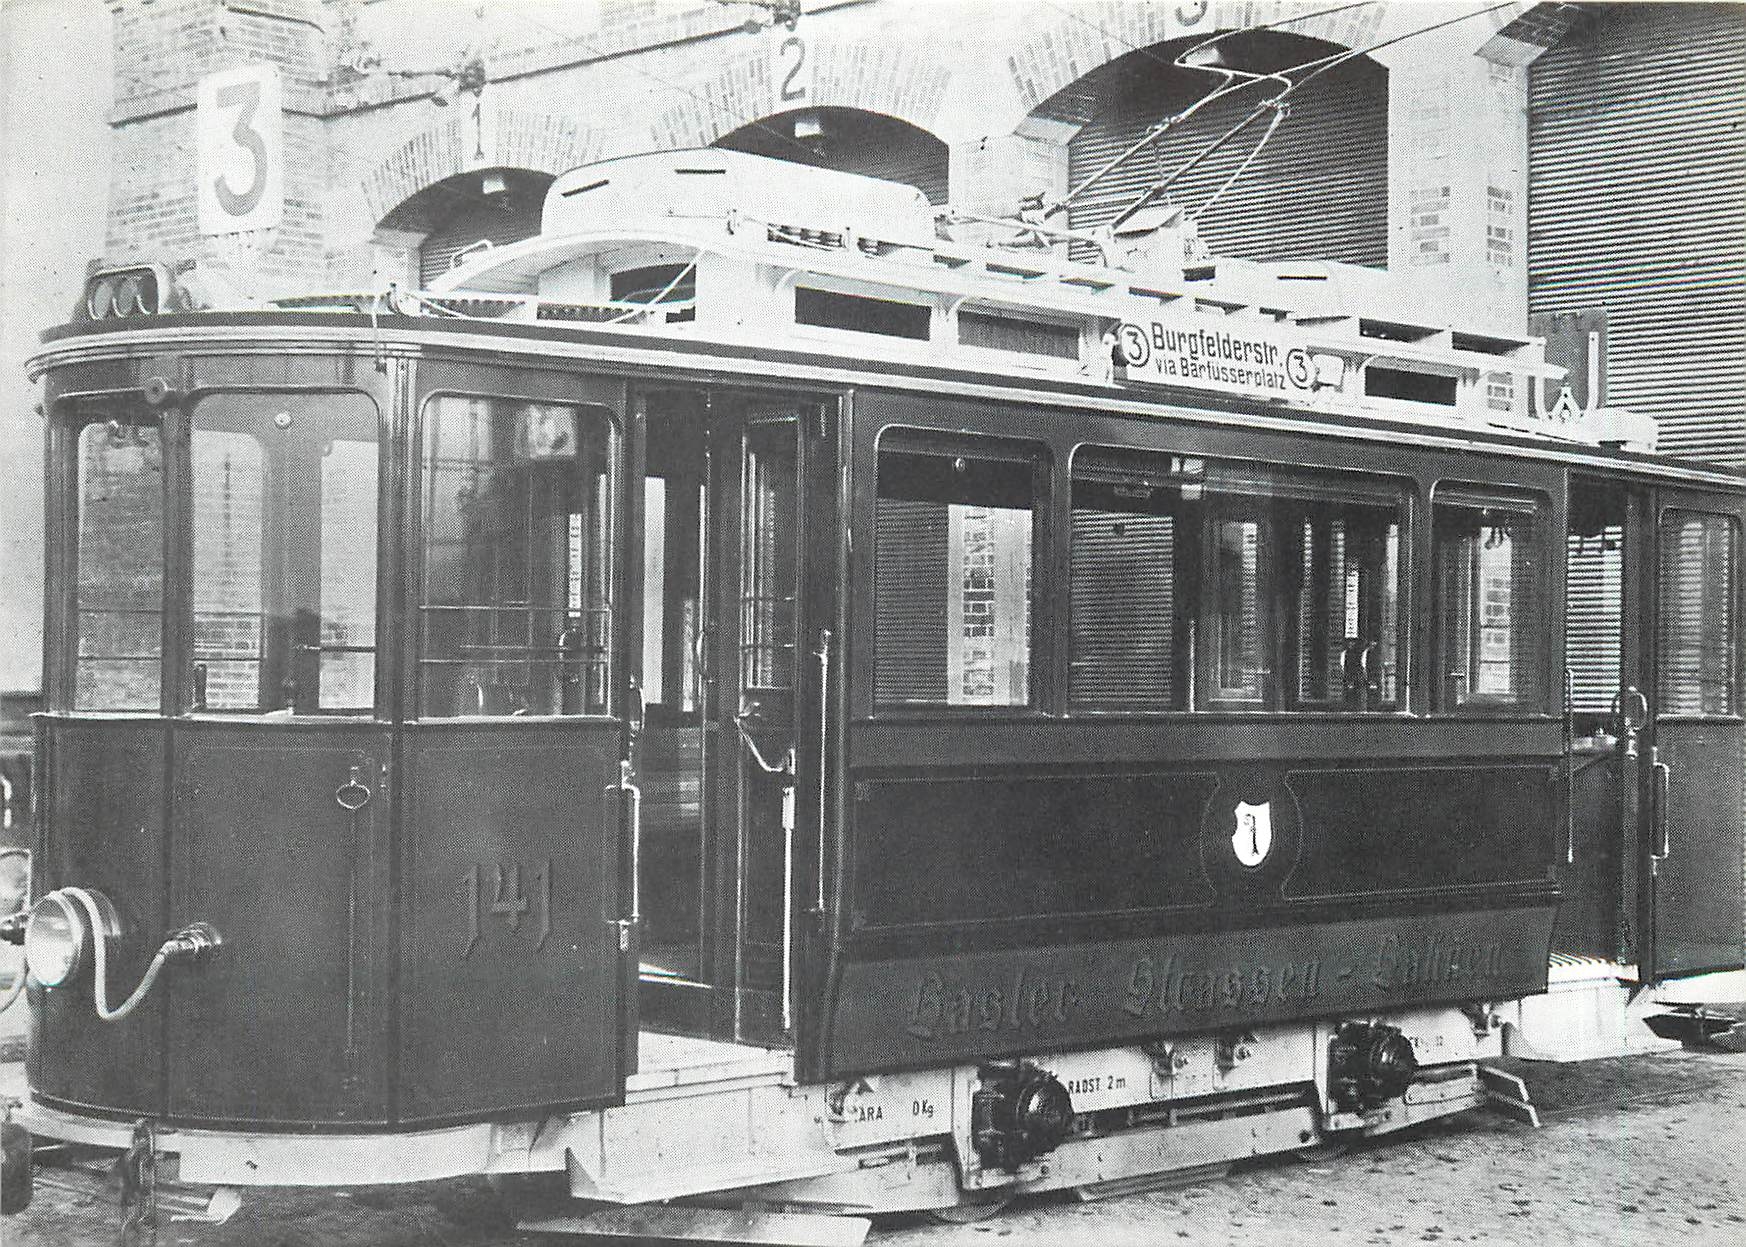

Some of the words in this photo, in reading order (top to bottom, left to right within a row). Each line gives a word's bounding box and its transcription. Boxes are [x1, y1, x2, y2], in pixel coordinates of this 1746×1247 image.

[779, 36, 806, 101] 2
[213, 80, 268, 217] 3
[471, 102, 485, 160] 1
[1125, 330, 1143, 361] 3
[1151, 321, 1284, 368] Burgfelderstr.
[1155, 356, 1177, 376] via
[1292, 354, 1308, 383] 3
[459, 859, 552, 961] 141
[906, 969, 1079, 1040] Basler
[854, 1105, 883, 1124] ARA
